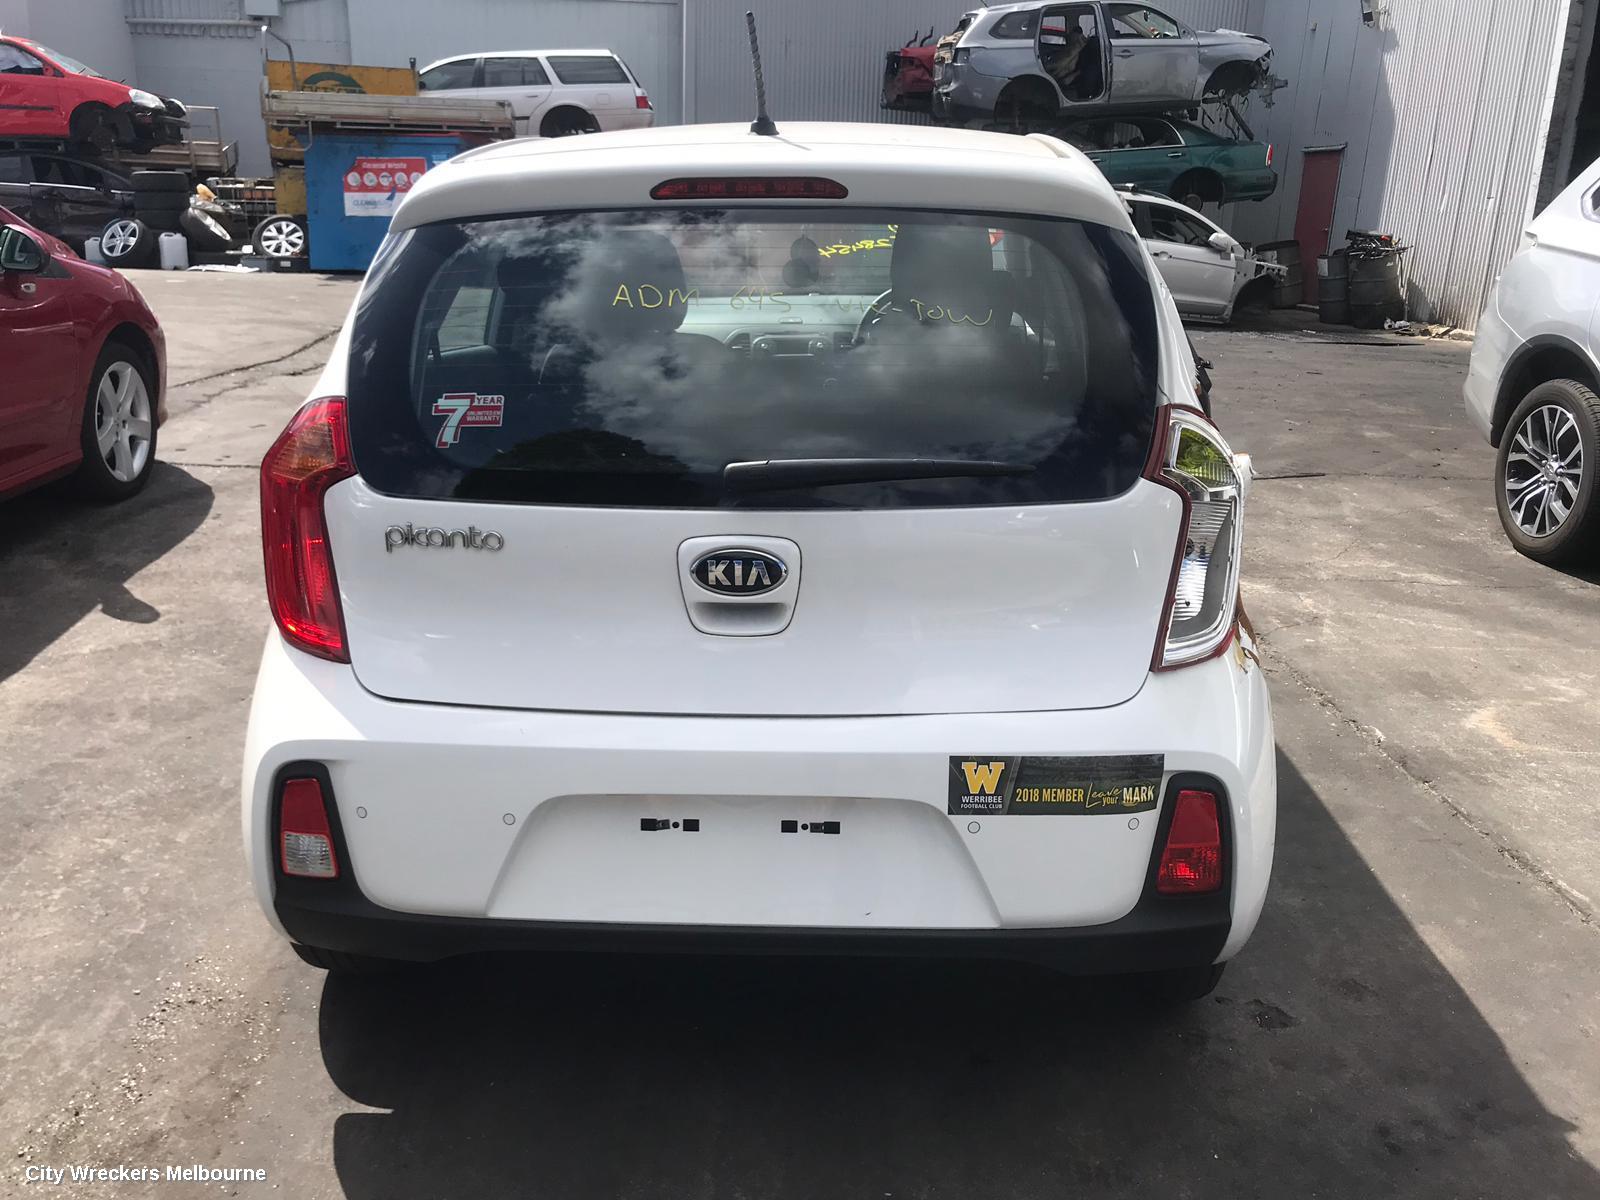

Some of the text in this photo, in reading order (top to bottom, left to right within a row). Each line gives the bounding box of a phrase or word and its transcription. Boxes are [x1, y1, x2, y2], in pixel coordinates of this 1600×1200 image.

[612, 284, 700, 308] ADM
[433, 393, 503, 447] 7 YEAR
[384, 521, 504, 553] picanto
[706, 559, 772, 586] KIA
[961, 761, 1006, 795] W
[961, 795, 1003, 804] WERRIBEE
[1015, 787, 1084, 803] 2018 MEMBER
[1085, 783, 1123, 809] Leave
[1102, 796, 1118, 807] your
[1122, 784, 1155, 803] MARK
